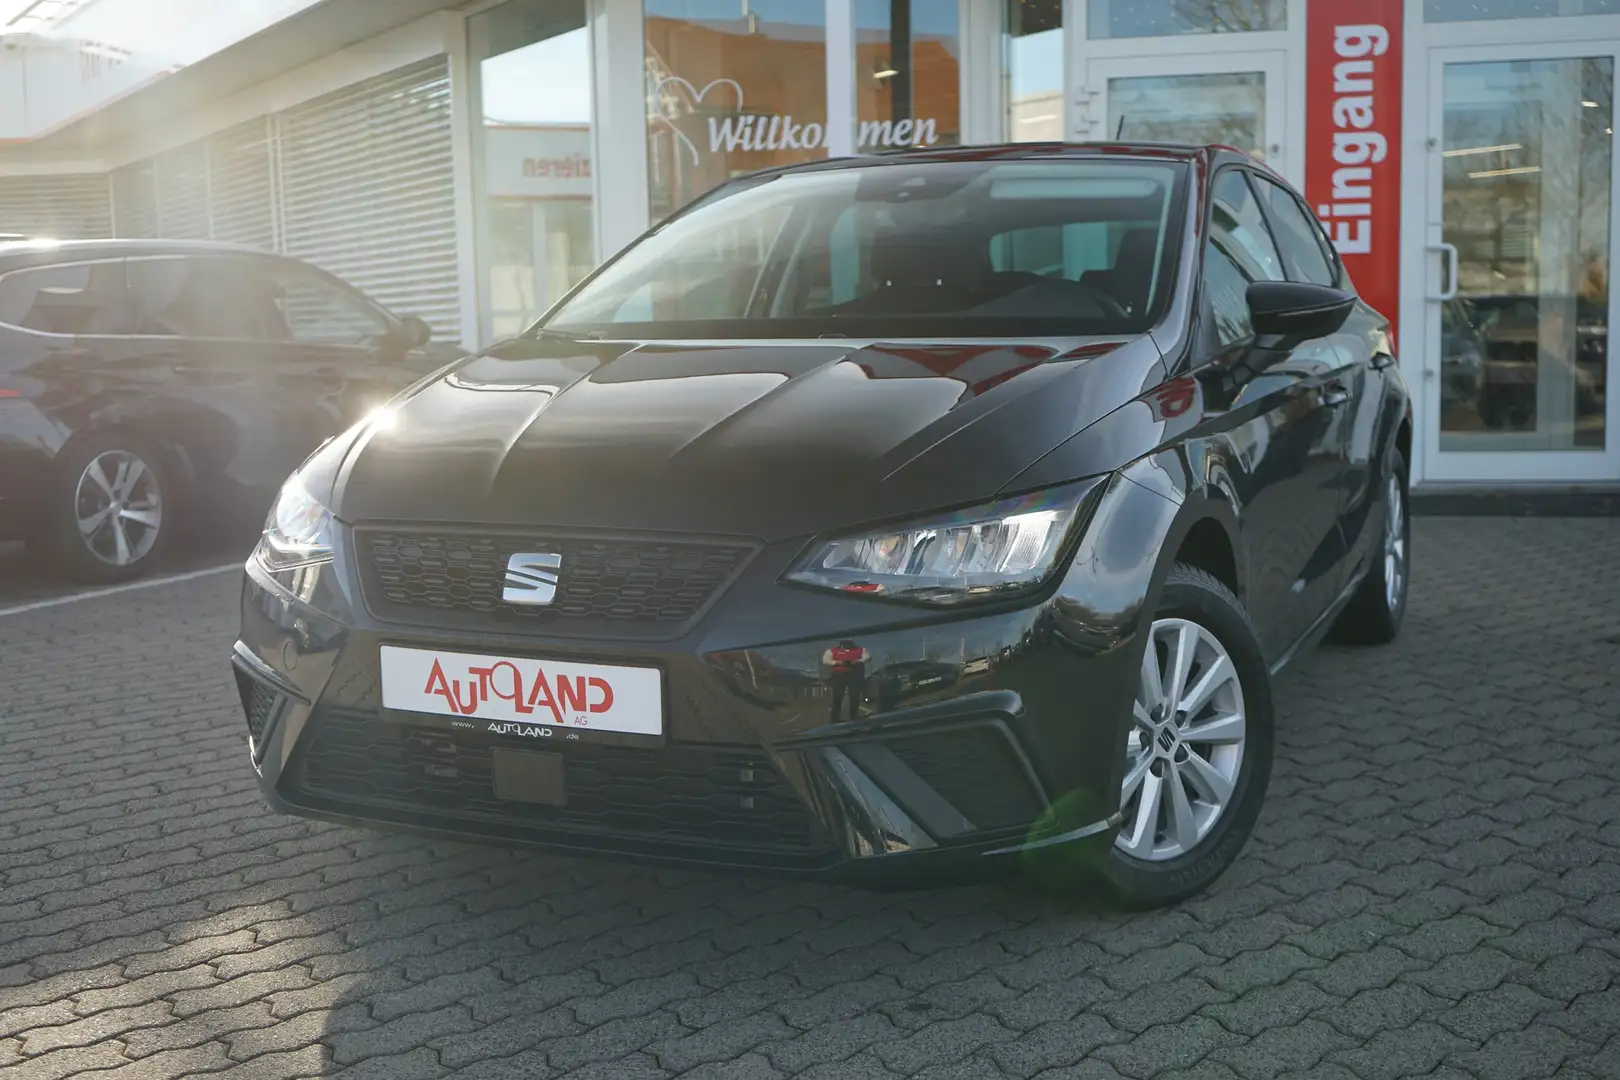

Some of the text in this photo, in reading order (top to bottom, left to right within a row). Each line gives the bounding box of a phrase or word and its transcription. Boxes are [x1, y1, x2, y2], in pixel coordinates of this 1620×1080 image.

[708, 115, 939, 153] Willkomen
[1318, 24, 1389, 254] Eingang
[424, 657, 614, 724] AUTOLAND
[451, 721, 580, 741] www. AUTOLAND .de
[574, 715, 588, 726] AG
